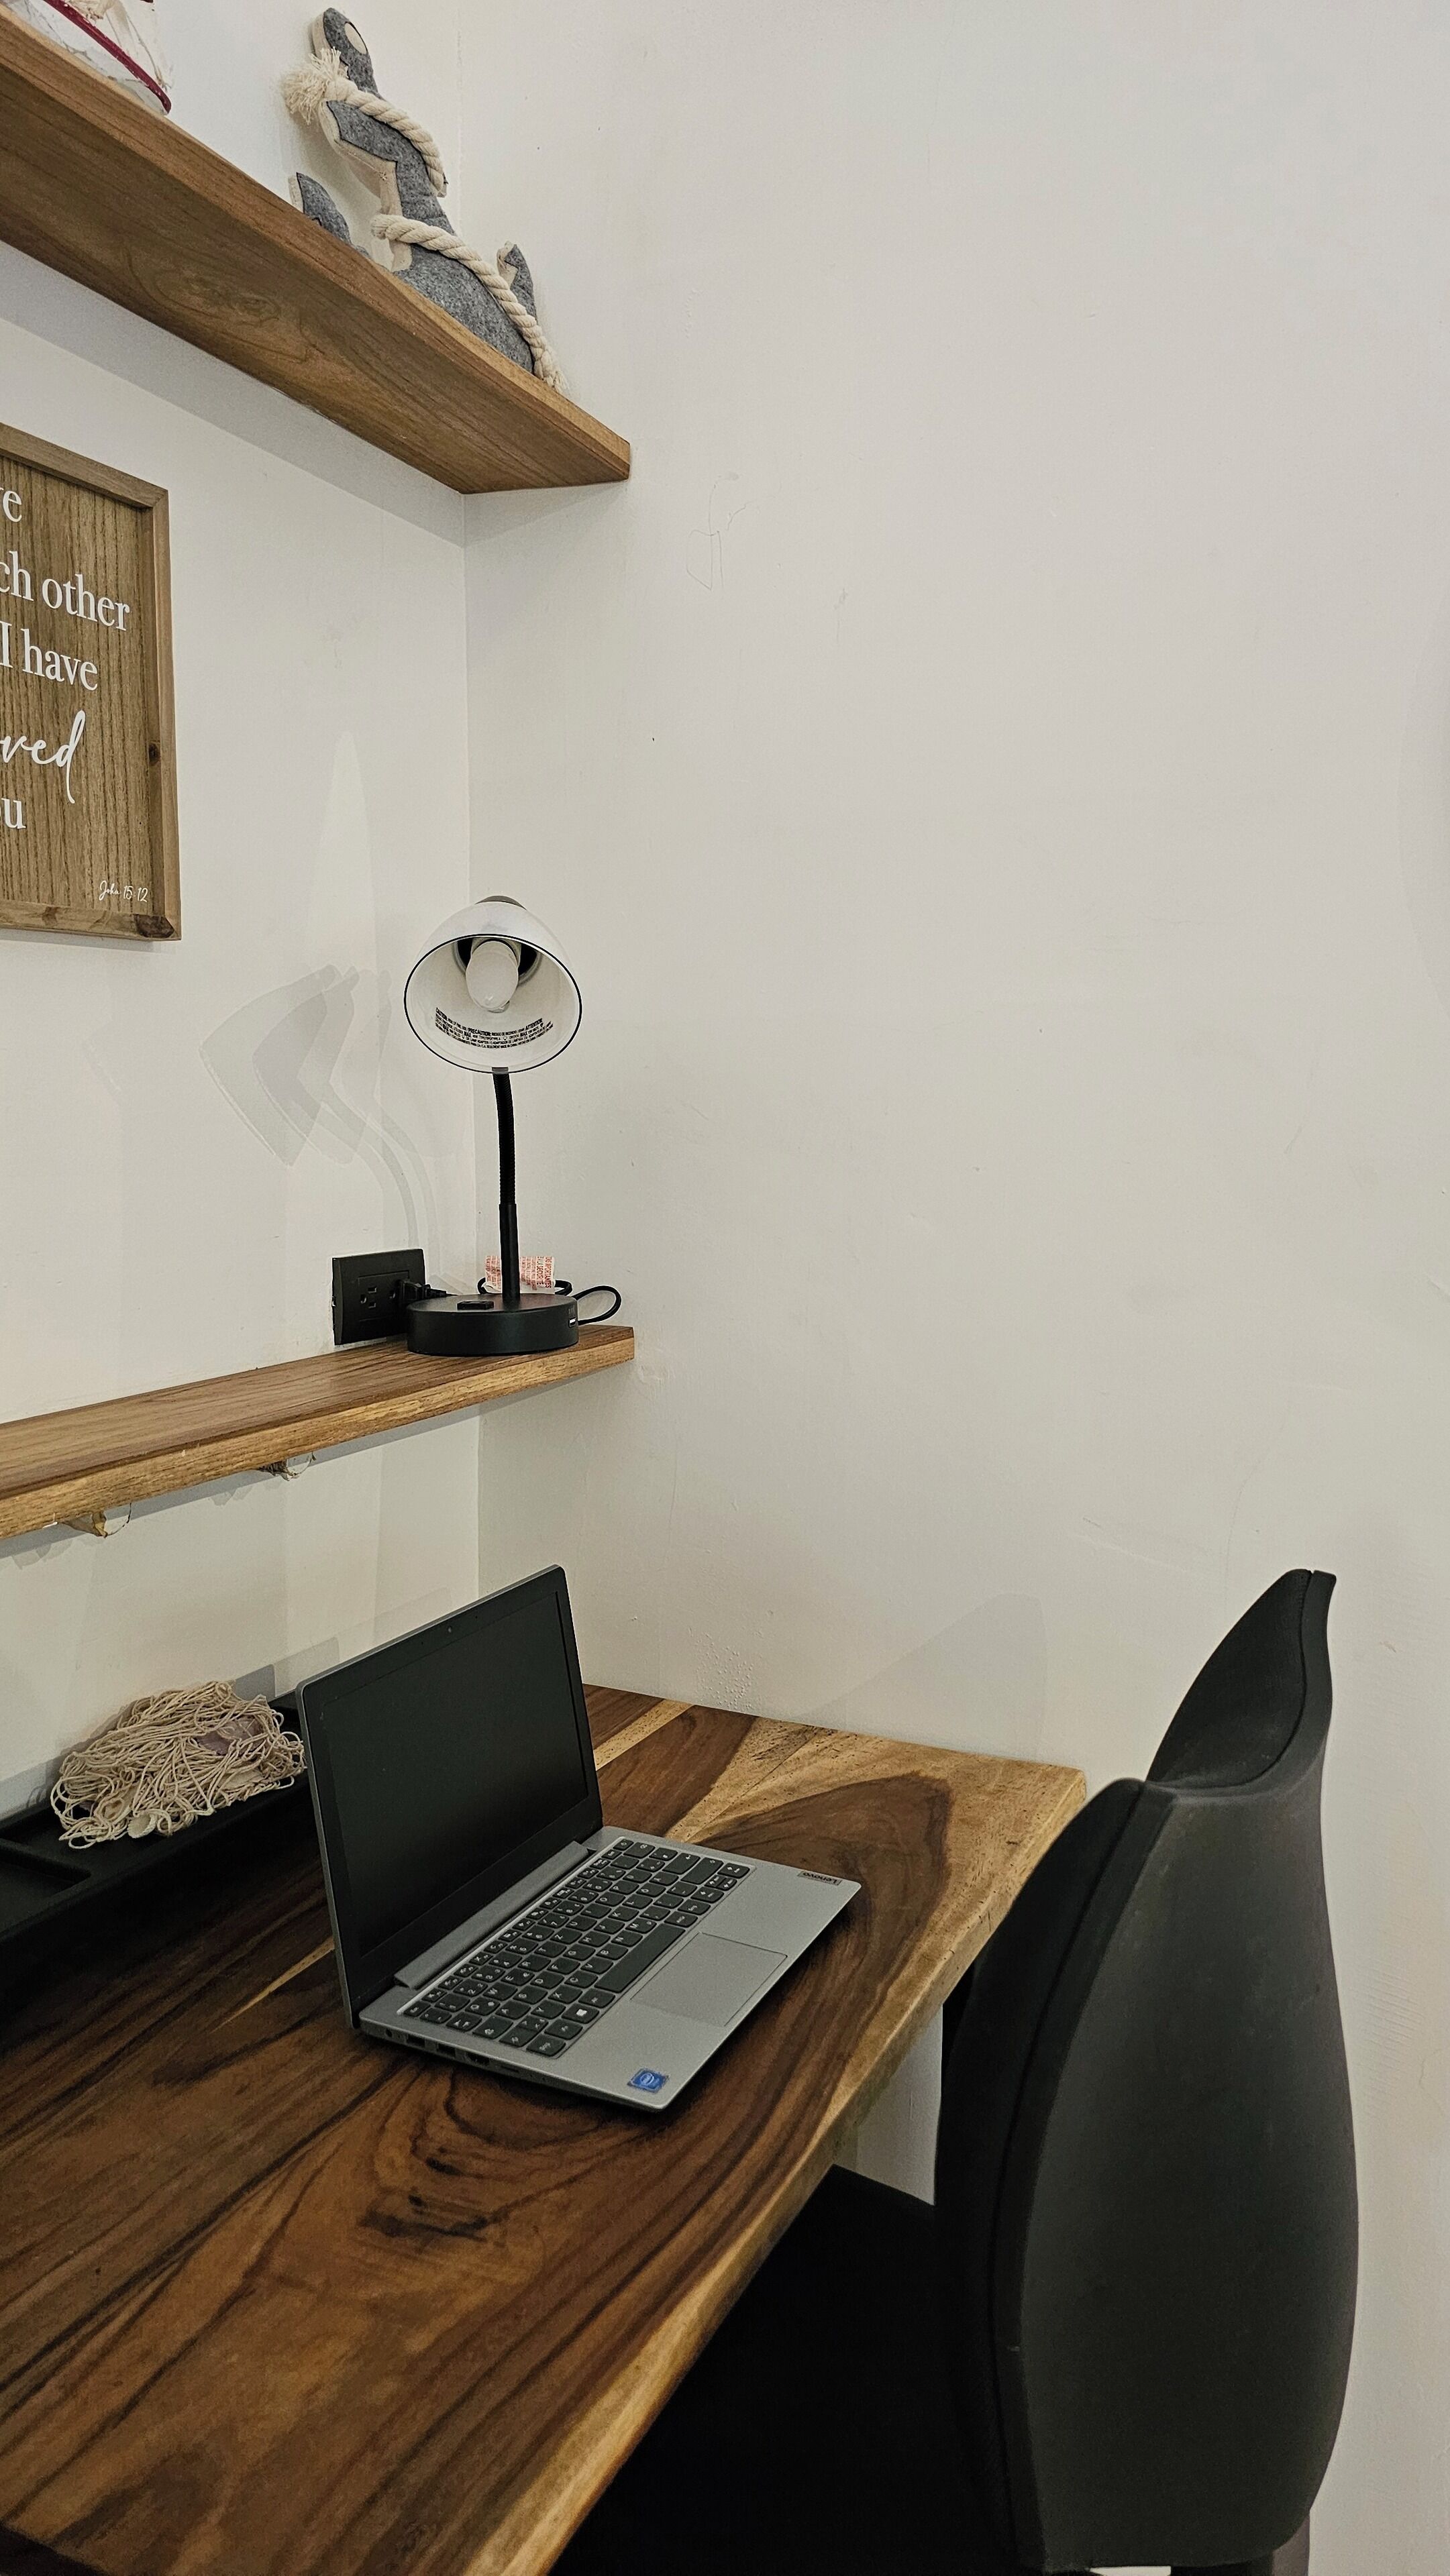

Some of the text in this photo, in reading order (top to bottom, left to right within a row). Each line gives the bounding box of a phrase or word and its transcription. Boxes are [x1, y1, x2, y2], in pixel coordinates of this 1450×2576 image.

[0, 487, 22, 523] e
[42, 573, 130, 631] other
[0, 620, 98, 692] I have
[99, 880, 120, 901] John
[802, 1872, 838, 1884] Lenovo
